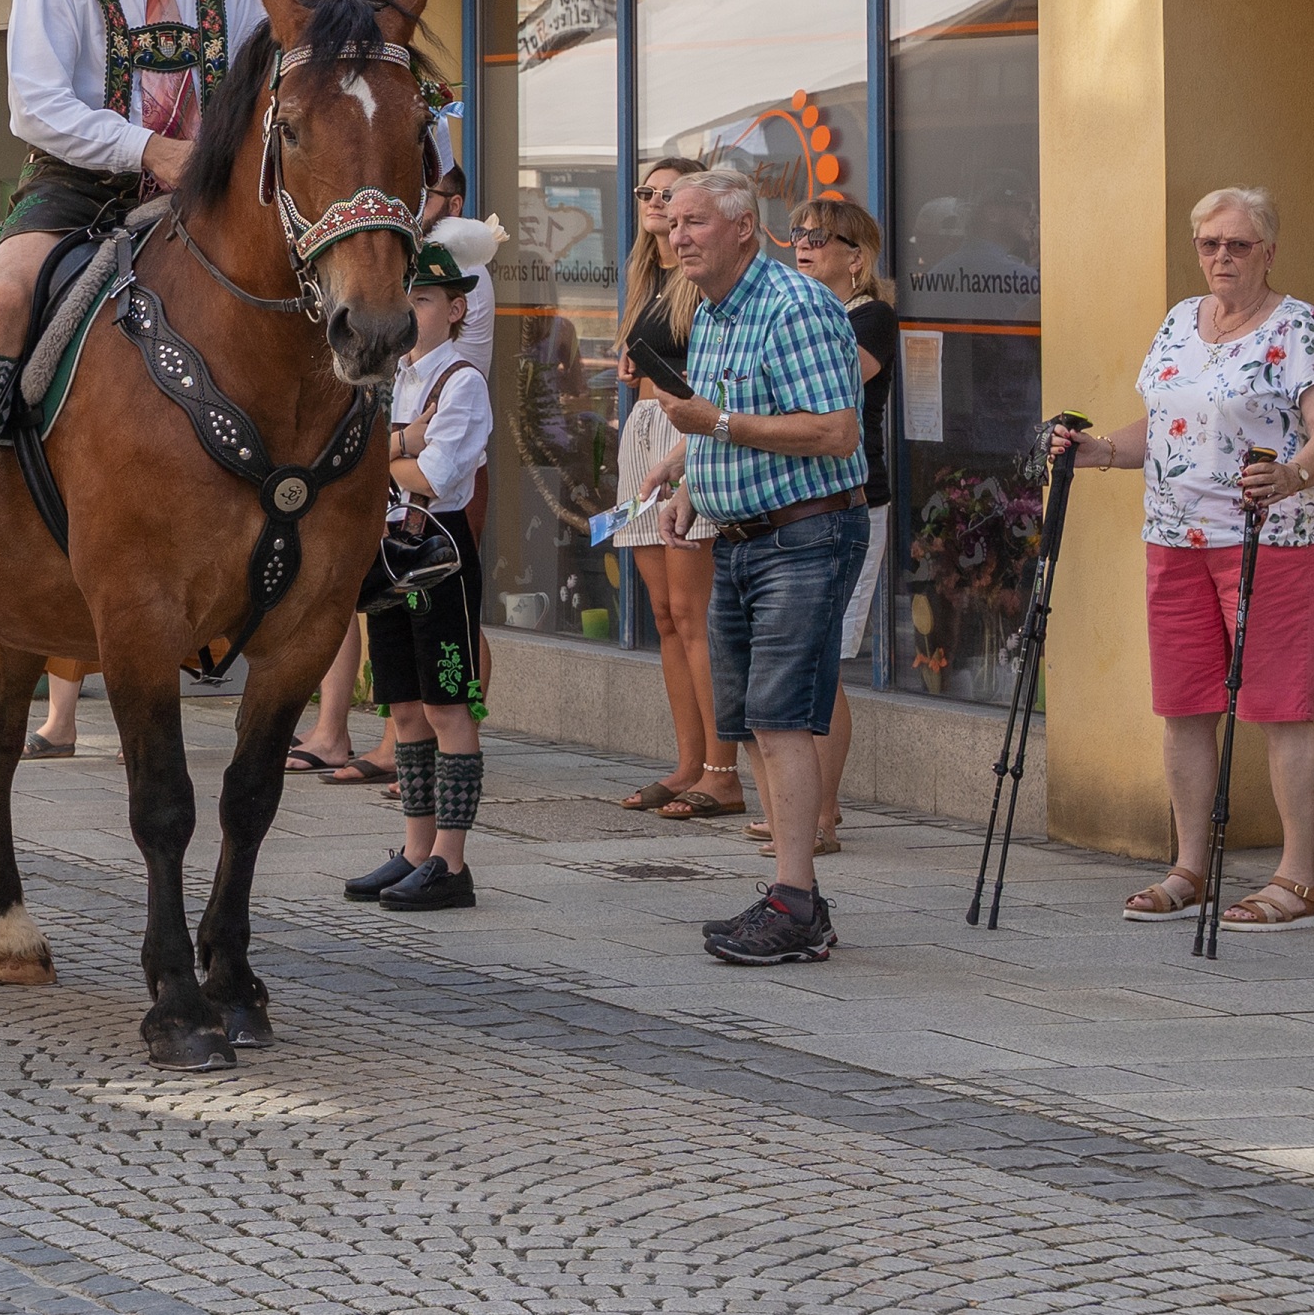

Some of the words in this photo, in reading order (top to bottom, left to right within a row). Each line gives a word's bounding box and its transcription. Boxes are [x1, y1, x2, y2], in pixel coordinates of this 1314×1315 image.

[491, 259, 529, 283] Praxis
[531, 259, 551, 283] für
[910, 267, 1041, 295] www.haxnstad
